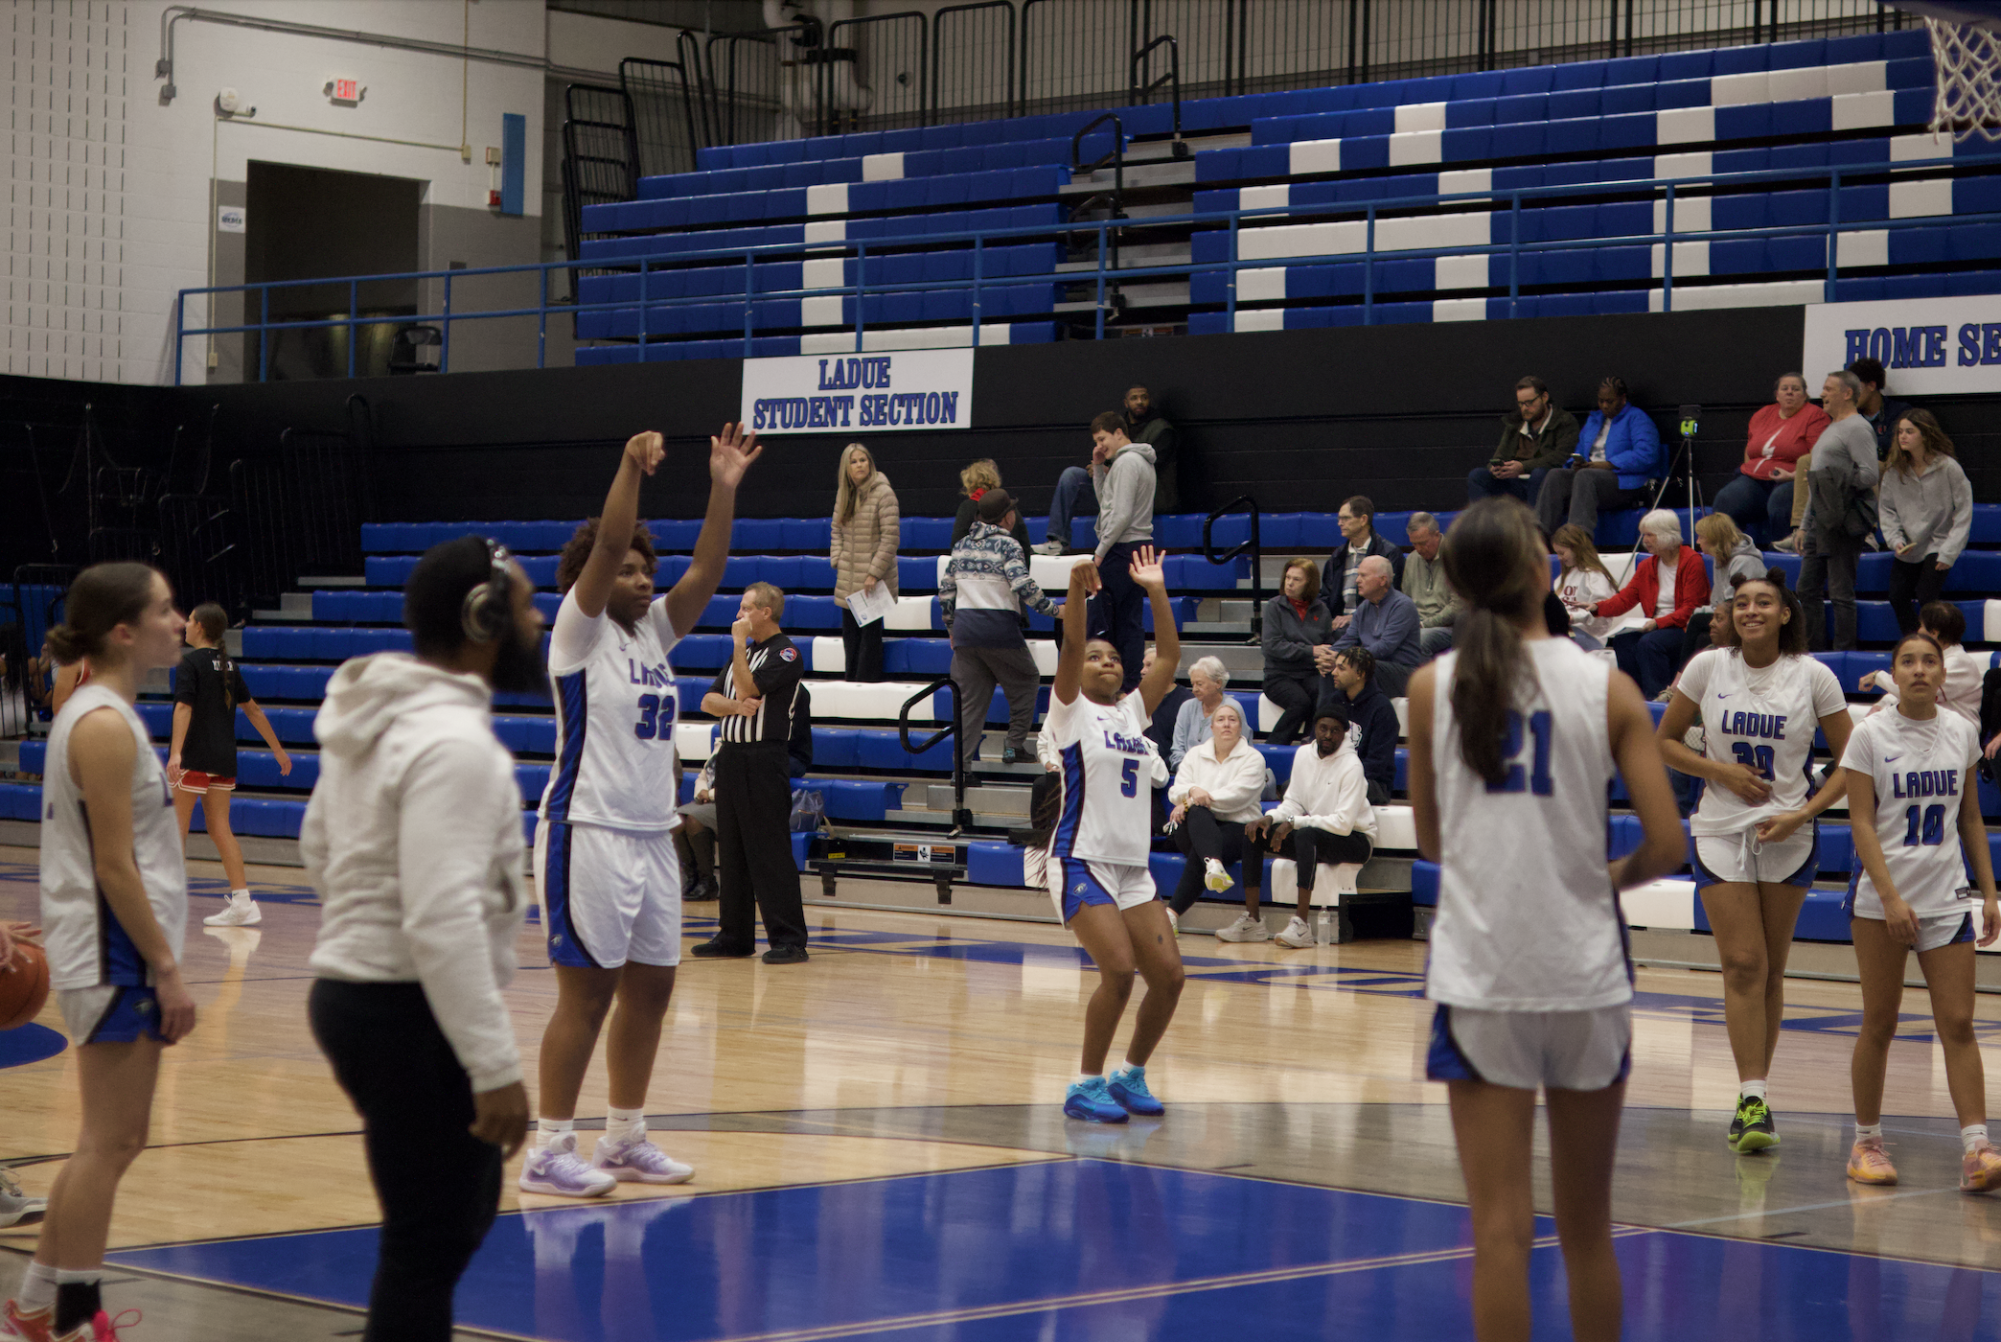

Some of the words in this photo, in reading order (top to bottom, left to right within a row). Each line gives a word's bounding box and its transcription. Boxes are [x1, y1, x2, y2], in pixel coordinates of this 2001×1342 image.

[337, 79, 357, 99] EXIT
[1843, 325, 1948, 370] HOME
[1957, 322, 2001, 367] SE
[818, 356, 891, 390] LADUE
[753, 395, 854, 430] STUDENT
[859, 391, 959, 426] SECTION
[633, 693, 676, 741] 32
[1721, 709, 1788, 740] LADUE
[1483, 709, 1554, 797] 21
[1120, 757, 1140, 799] 5
[1893, 769, 1959, 799] LADUE
[1903, 803, 1947, 847] 10
